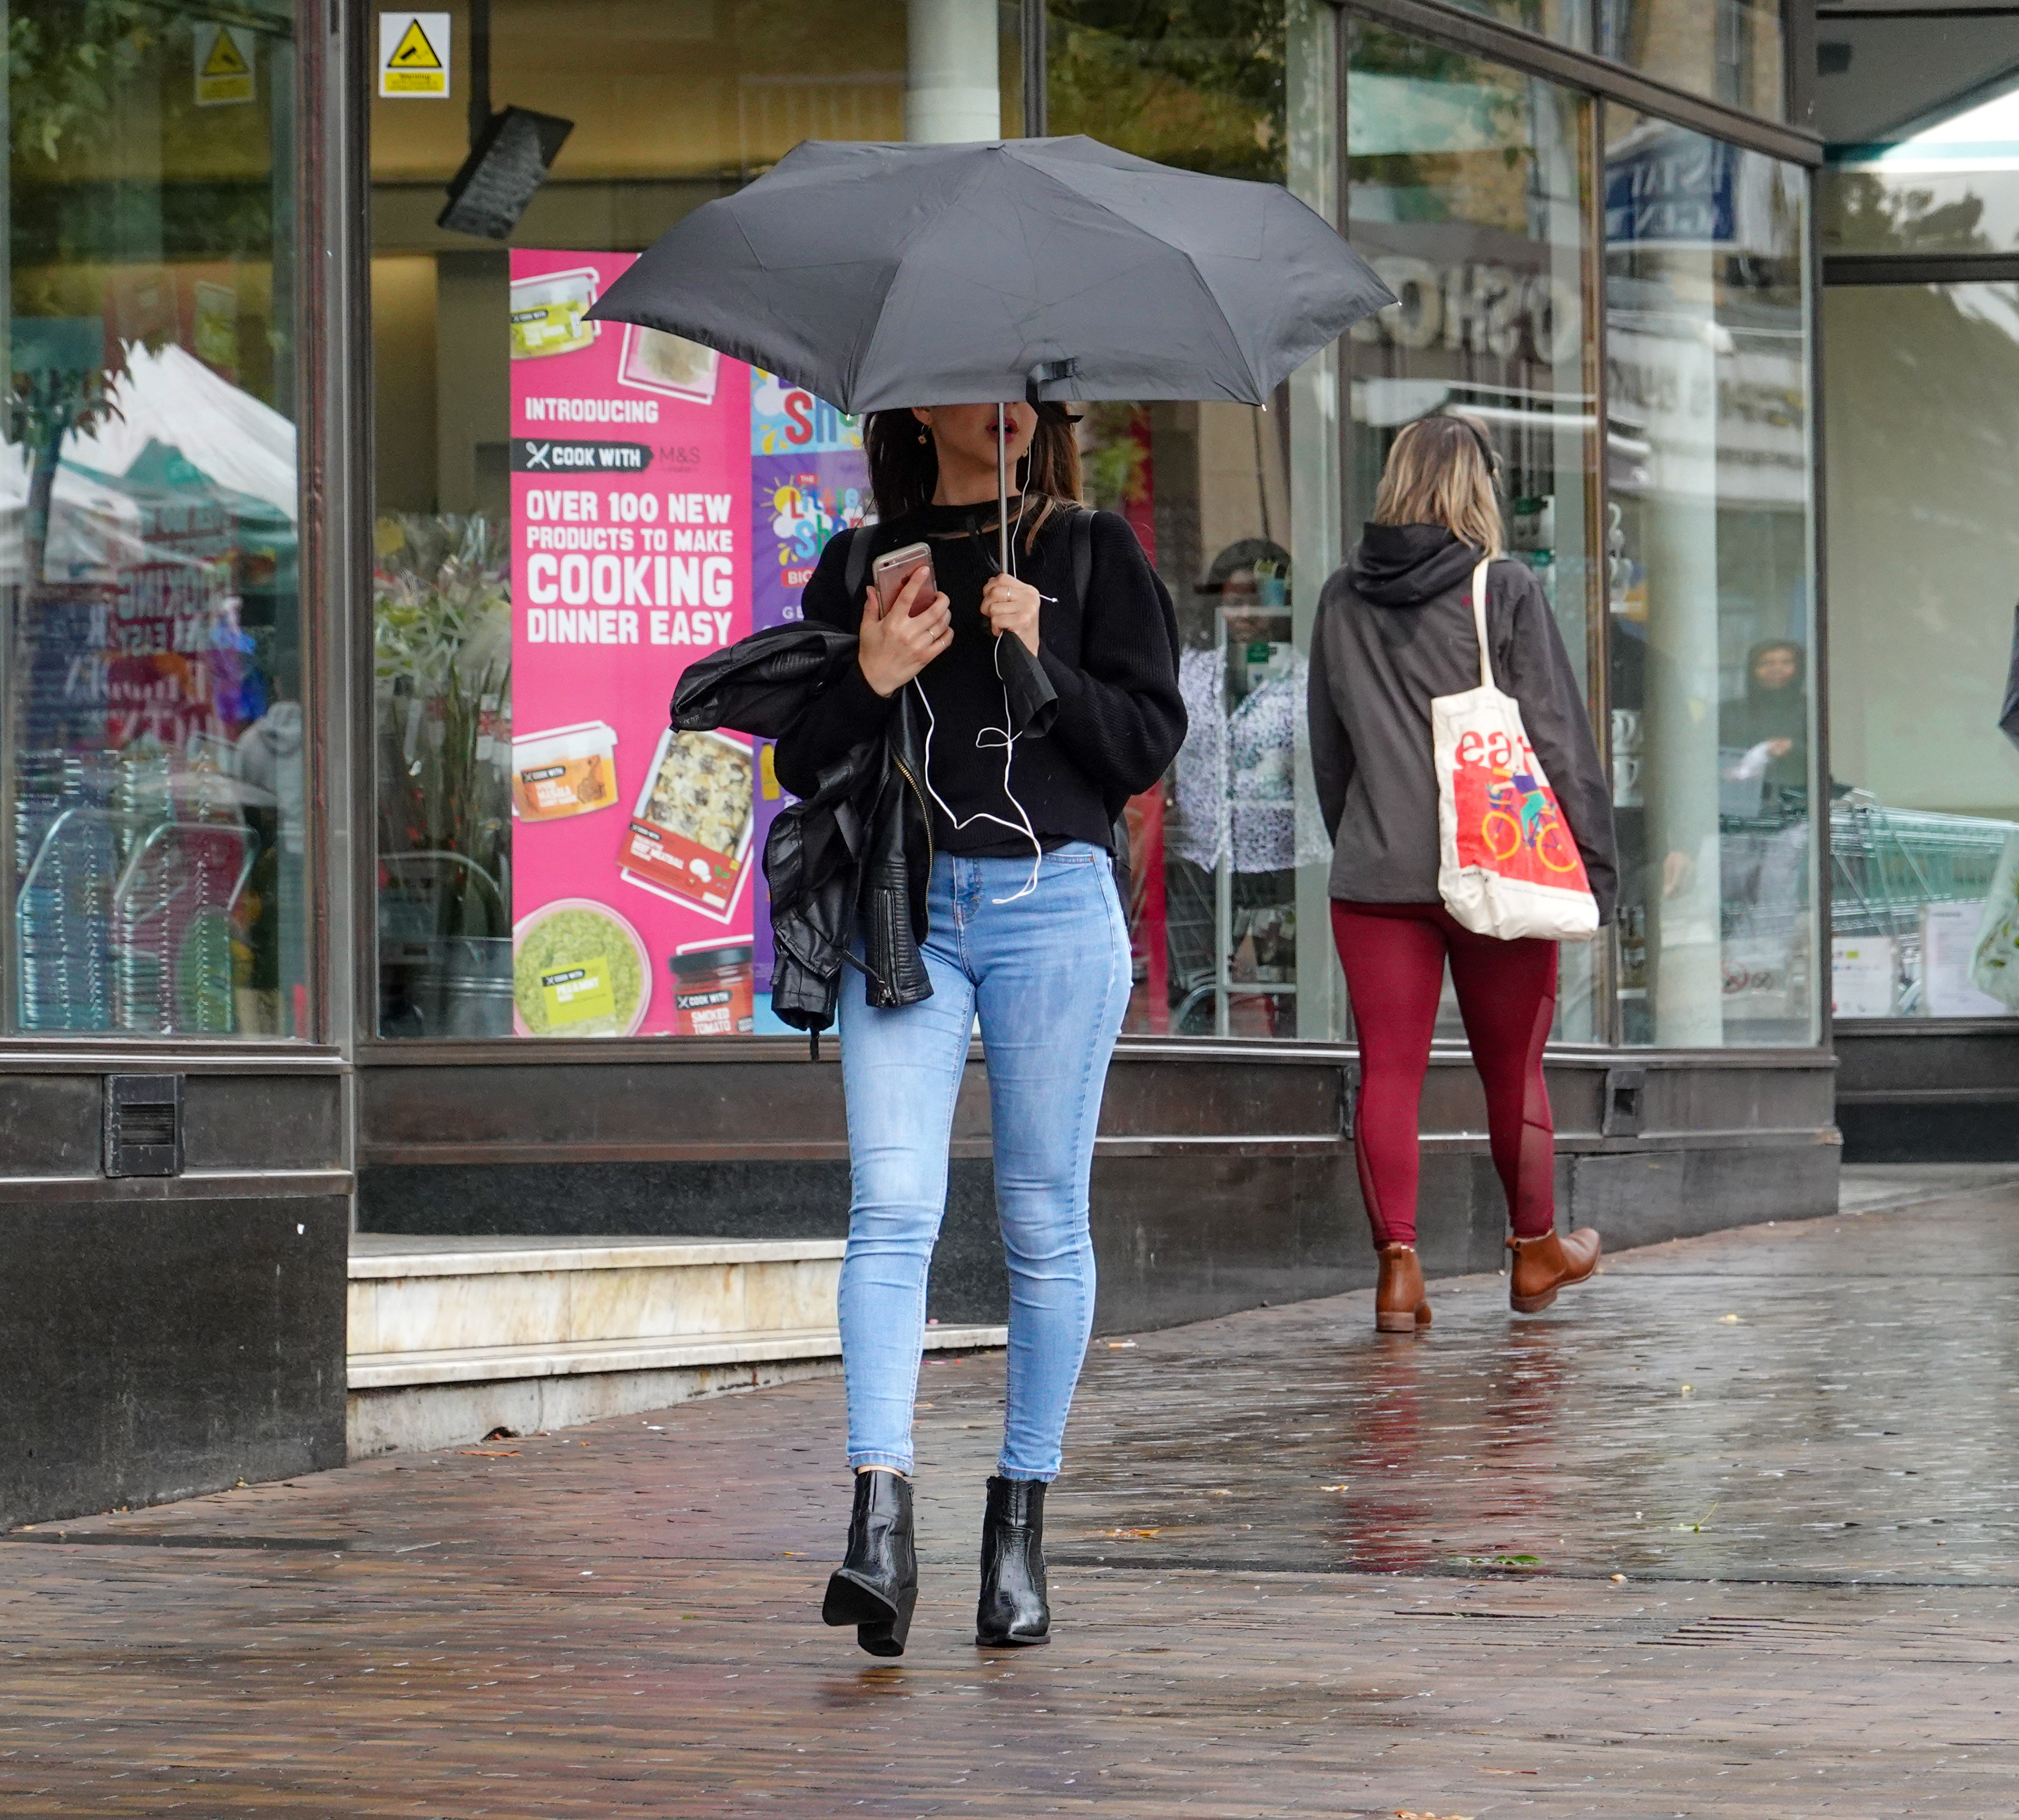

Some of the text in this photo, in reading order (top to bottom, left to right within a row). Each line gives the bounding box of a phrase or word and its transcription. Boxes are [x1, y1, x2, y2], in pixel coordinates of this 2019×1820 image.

[525, 397, 658, 423] INTRODUCING
[552, 446, 641, 467] COOK WITH
[659, 446, 701, 465] M&S
[800, 475, 815, 484] THE
[526, 490, 731, 523] OVER 100 NEW
[790, 488, 859, 519] Little
[526, 527, 733, 553] PRODUCTS TO MAKE
[528, 555, 732, 607] COOKING
[527, 609, 732, 646] DINNER EASY
[690, 1007, 730, 1023] SMOKED
[692, 1020, 731, 1035] TOMATO
